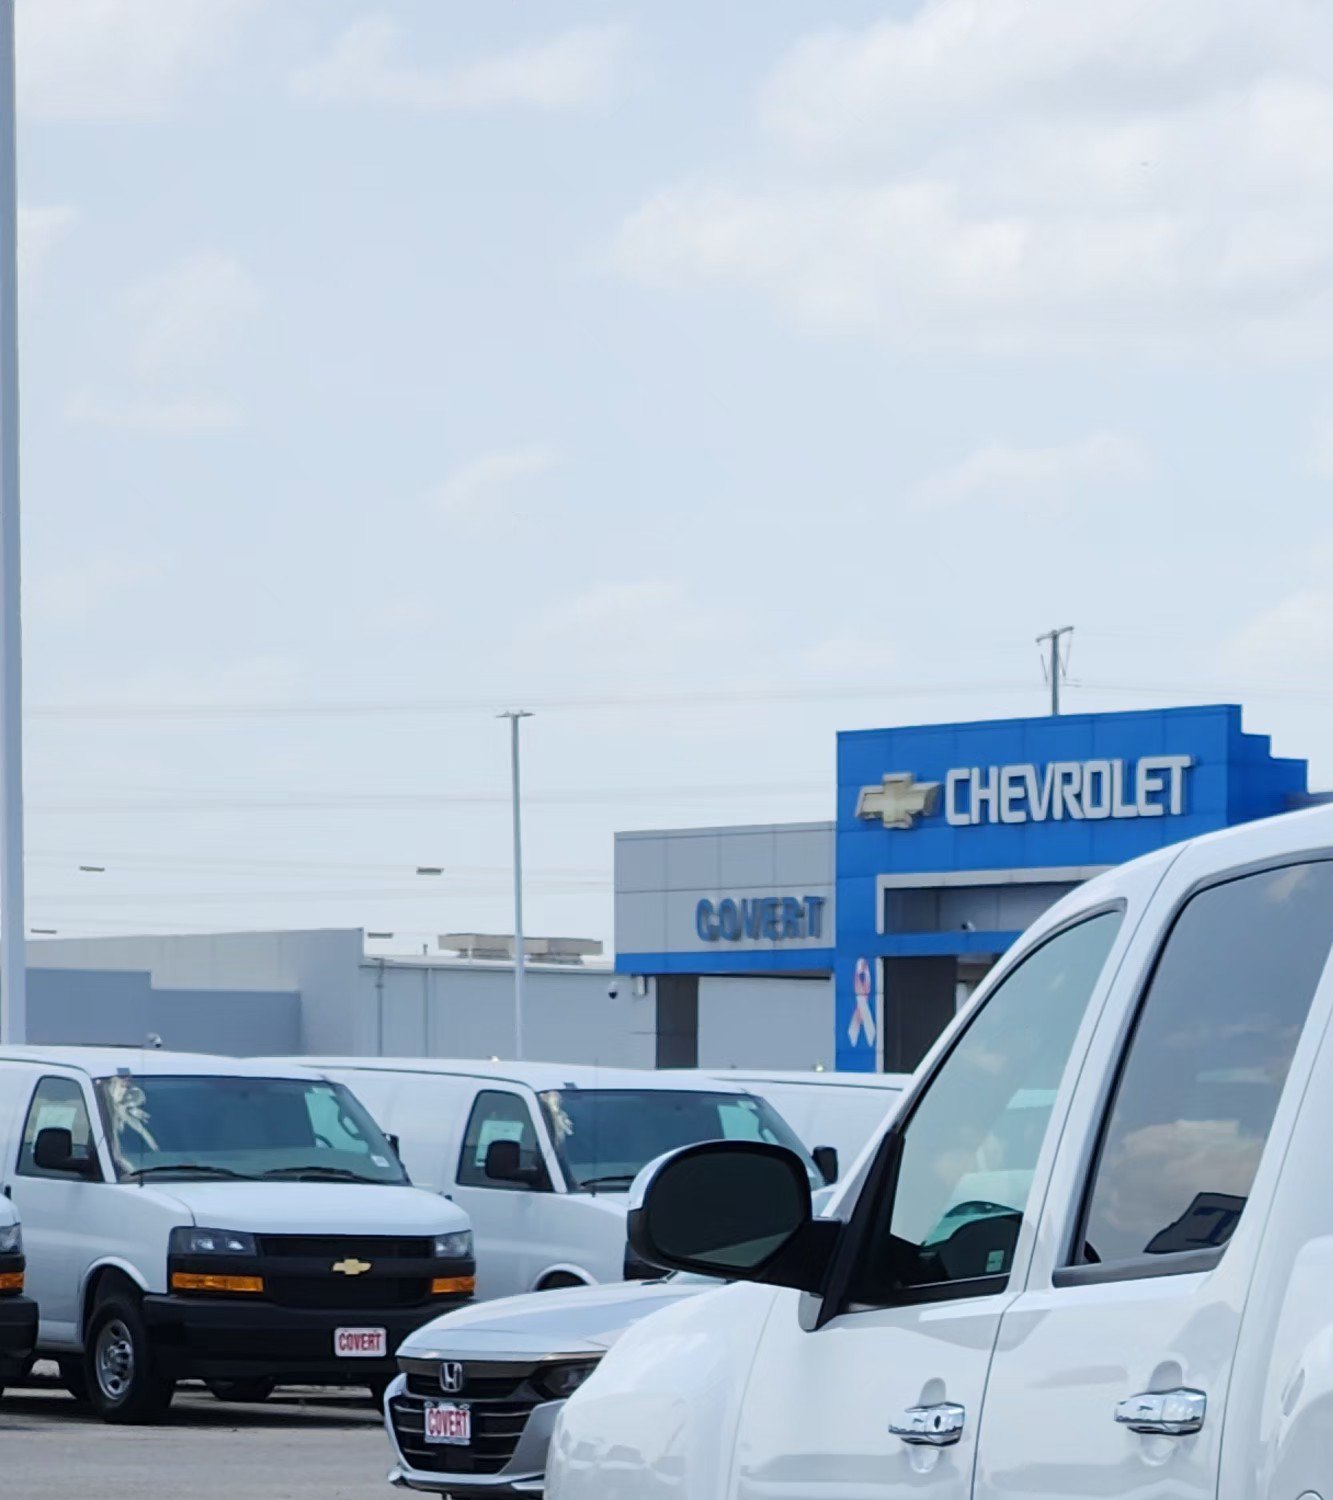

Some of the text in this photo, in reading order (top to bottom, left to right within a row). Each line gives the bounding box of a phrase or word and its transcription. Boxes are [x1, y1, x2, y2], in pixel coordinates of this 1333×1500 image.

[943, 755, 1194, 828] CHEVROLET
[695, 894, 826, 942] COVERT
[339, 1332, 382, 1351] COVERT
[428, 1408, 468, 1437] COVERT
